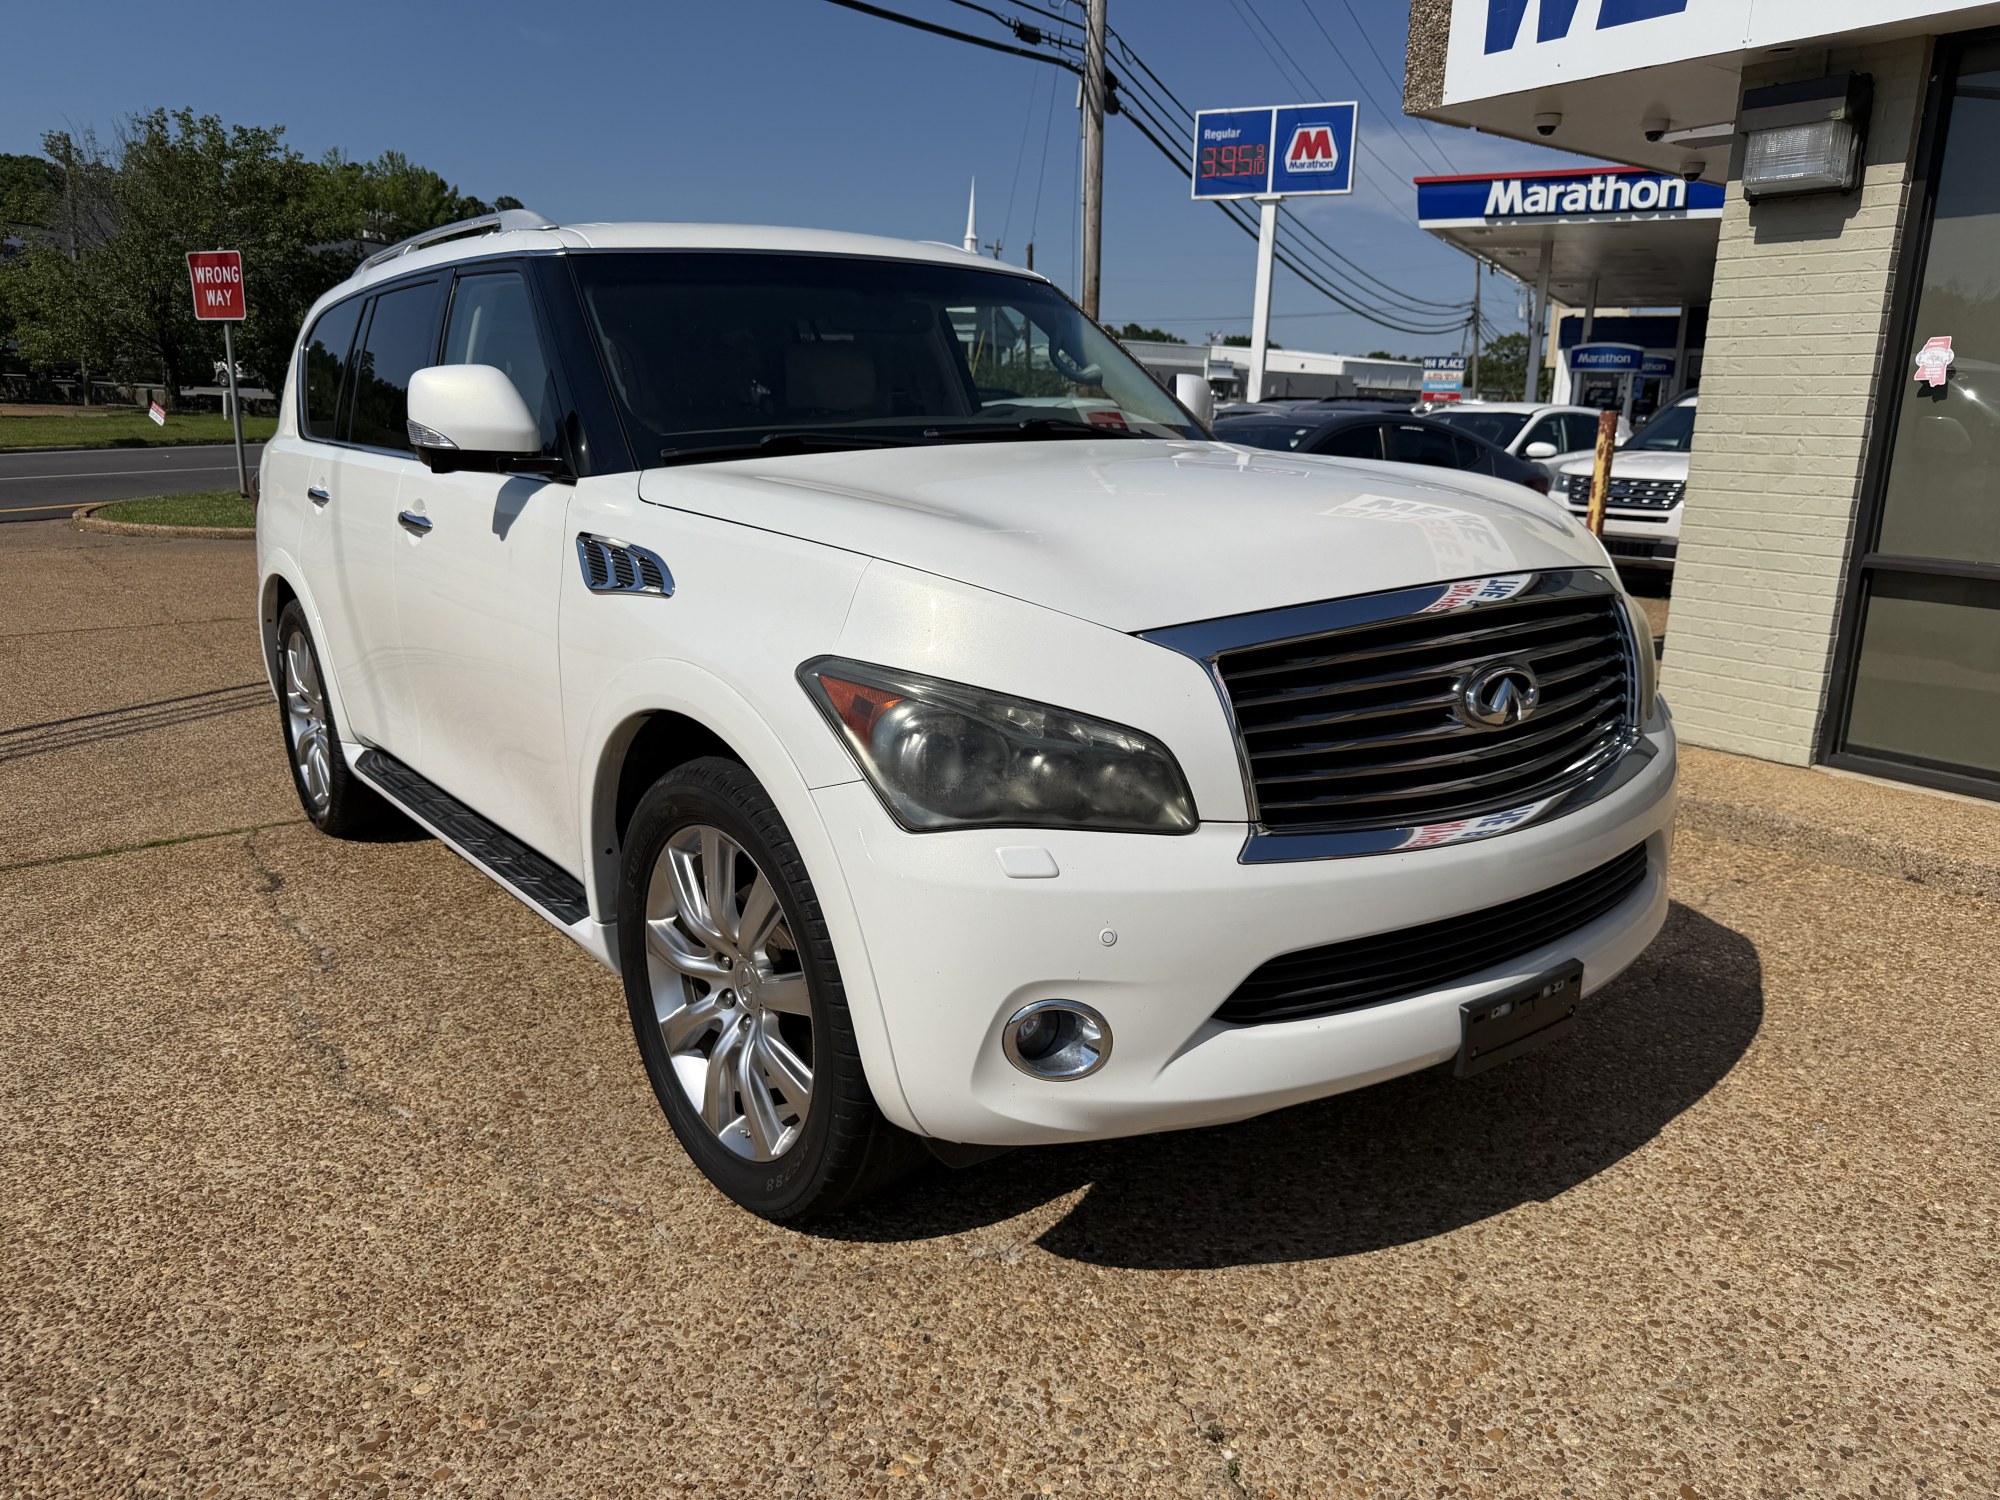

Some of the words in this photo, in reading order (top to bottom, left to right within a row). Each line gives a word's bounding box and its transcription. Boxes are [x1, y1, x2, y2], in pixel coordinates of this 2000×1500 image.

[1204, 129, 1241, 141] Regular
[1201, 145, 1252, 178] 3.95
[1289, 160, 1333, 170] Marathon
[1484, 174, 1687, 217] Marathon
[194, 265, 240, 284] WRONG
[205, 289, 232, 306] WAY
[1438, 358, 1464, 369] PLACE
[1577, 353, 1631, 363] Marathon
